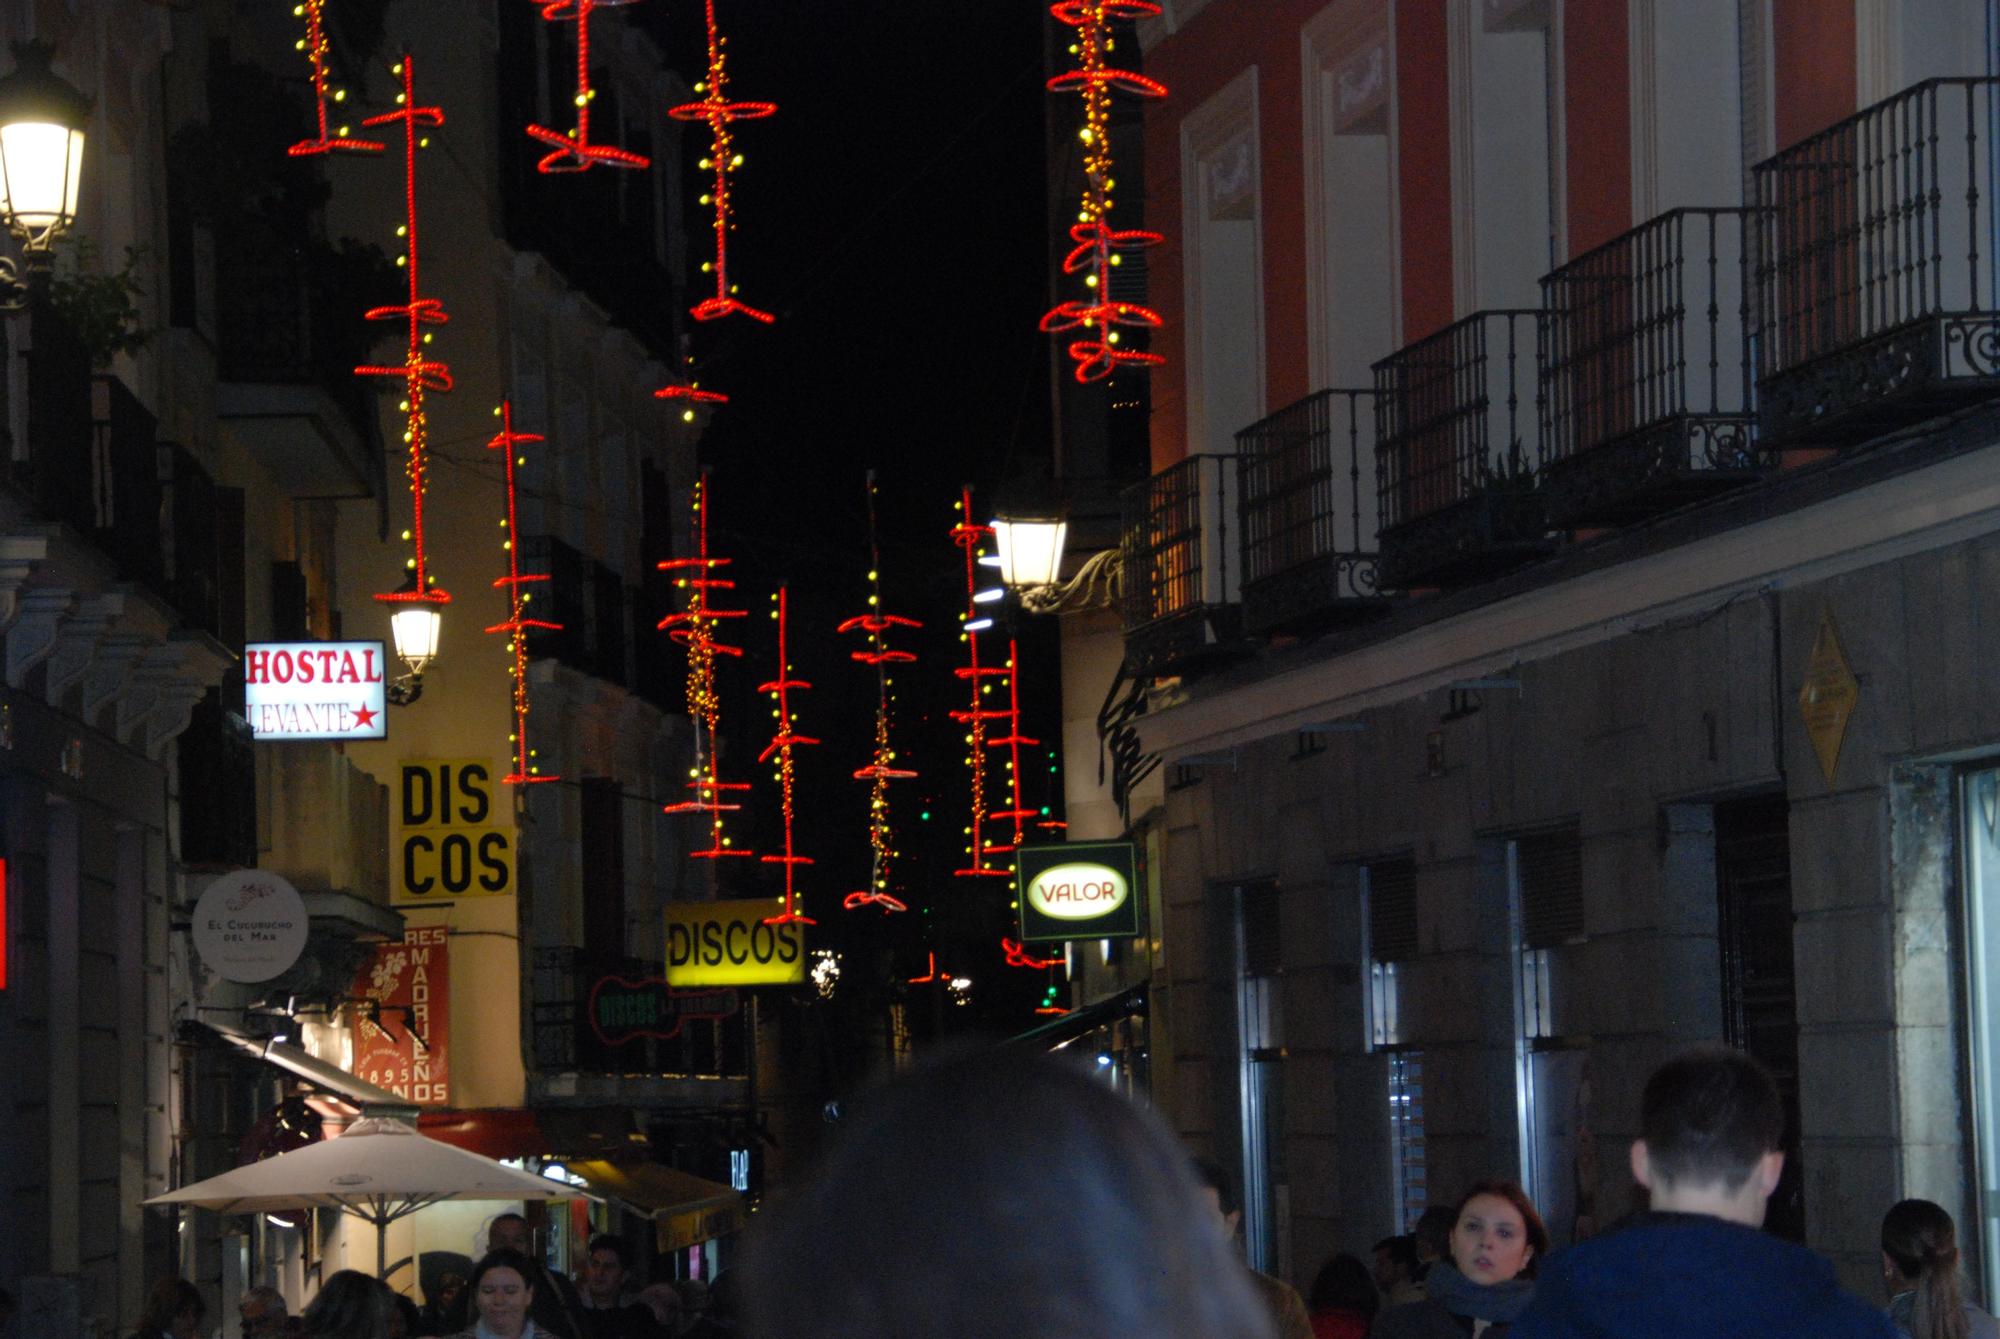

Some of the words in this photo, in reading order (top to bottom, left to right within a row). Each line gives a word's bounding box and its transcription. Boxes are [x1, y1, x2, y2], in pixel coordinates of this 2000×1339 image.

[246, 649, 382, 684] HOSTAL
[246, 703, 351, 733] LEVANTE
[402, 764, 489, 826] DIS
[404, 832, 509, 895] COS
[1039, 881, 1116, 903] VALOR
[668, 919, 799, 967] DISCOS
